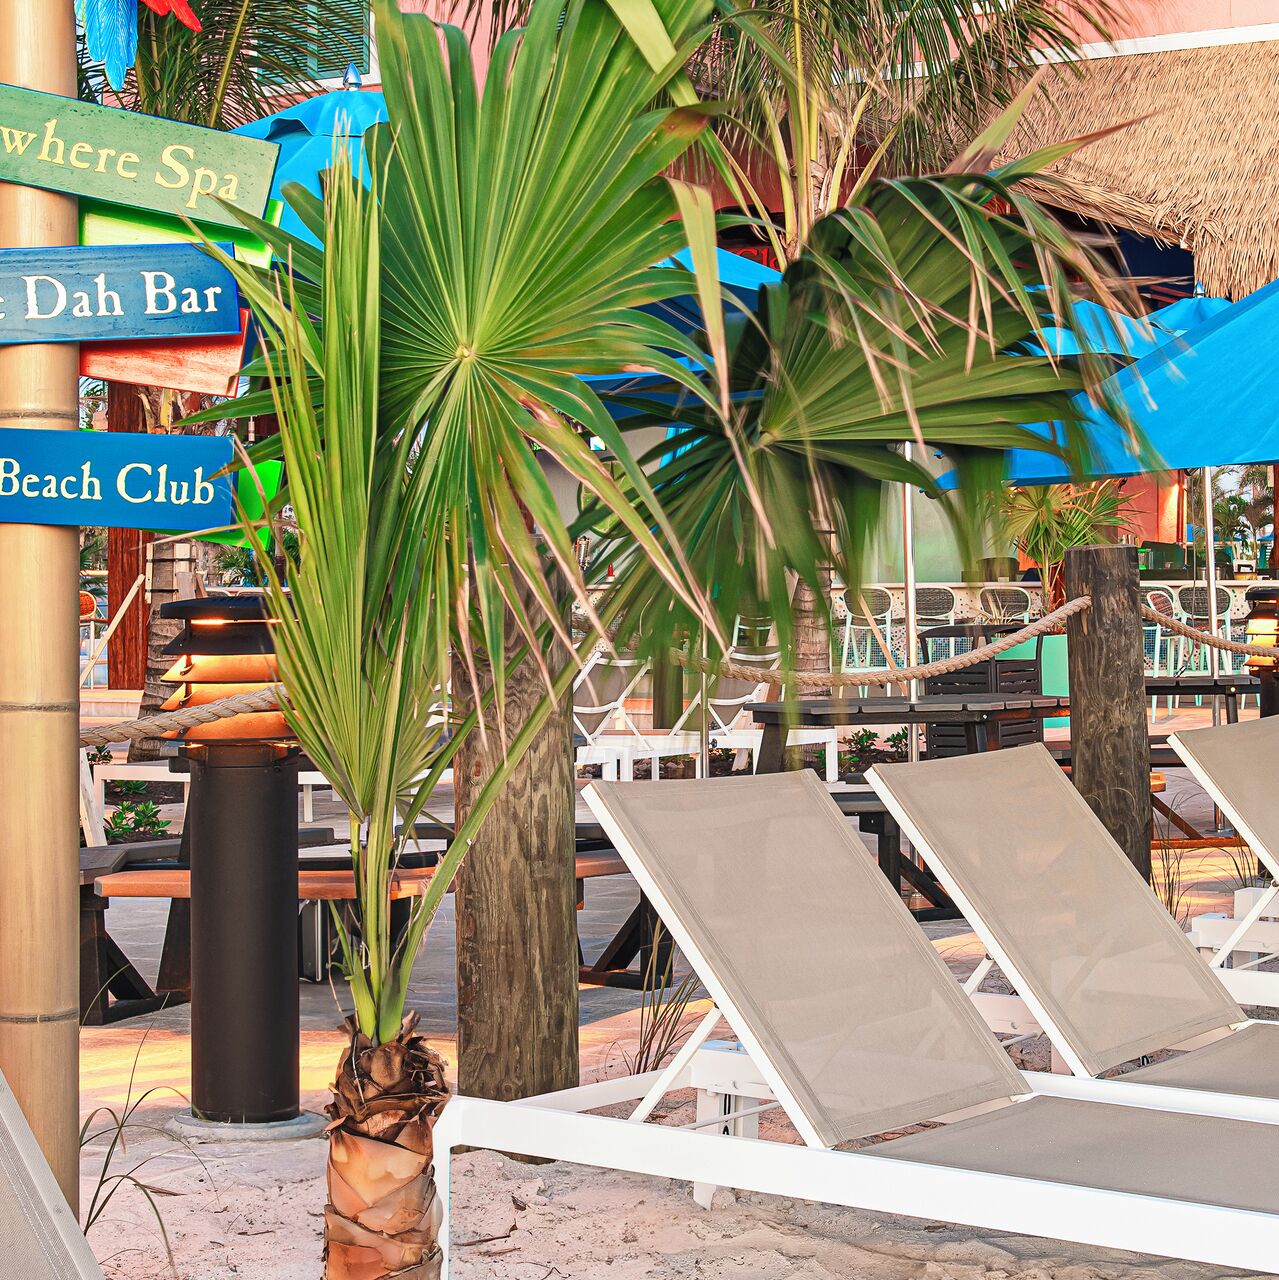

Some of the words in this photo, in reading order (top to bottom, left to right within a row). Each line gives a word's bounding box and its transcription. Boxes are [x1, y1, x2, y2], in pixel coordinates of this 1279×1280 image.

[154, 144, 238, 209] Spa
[20, 275, 124, 320] Dah
[141, 271, 222, 316] Bar
[116, 462, 215, 505] Club
